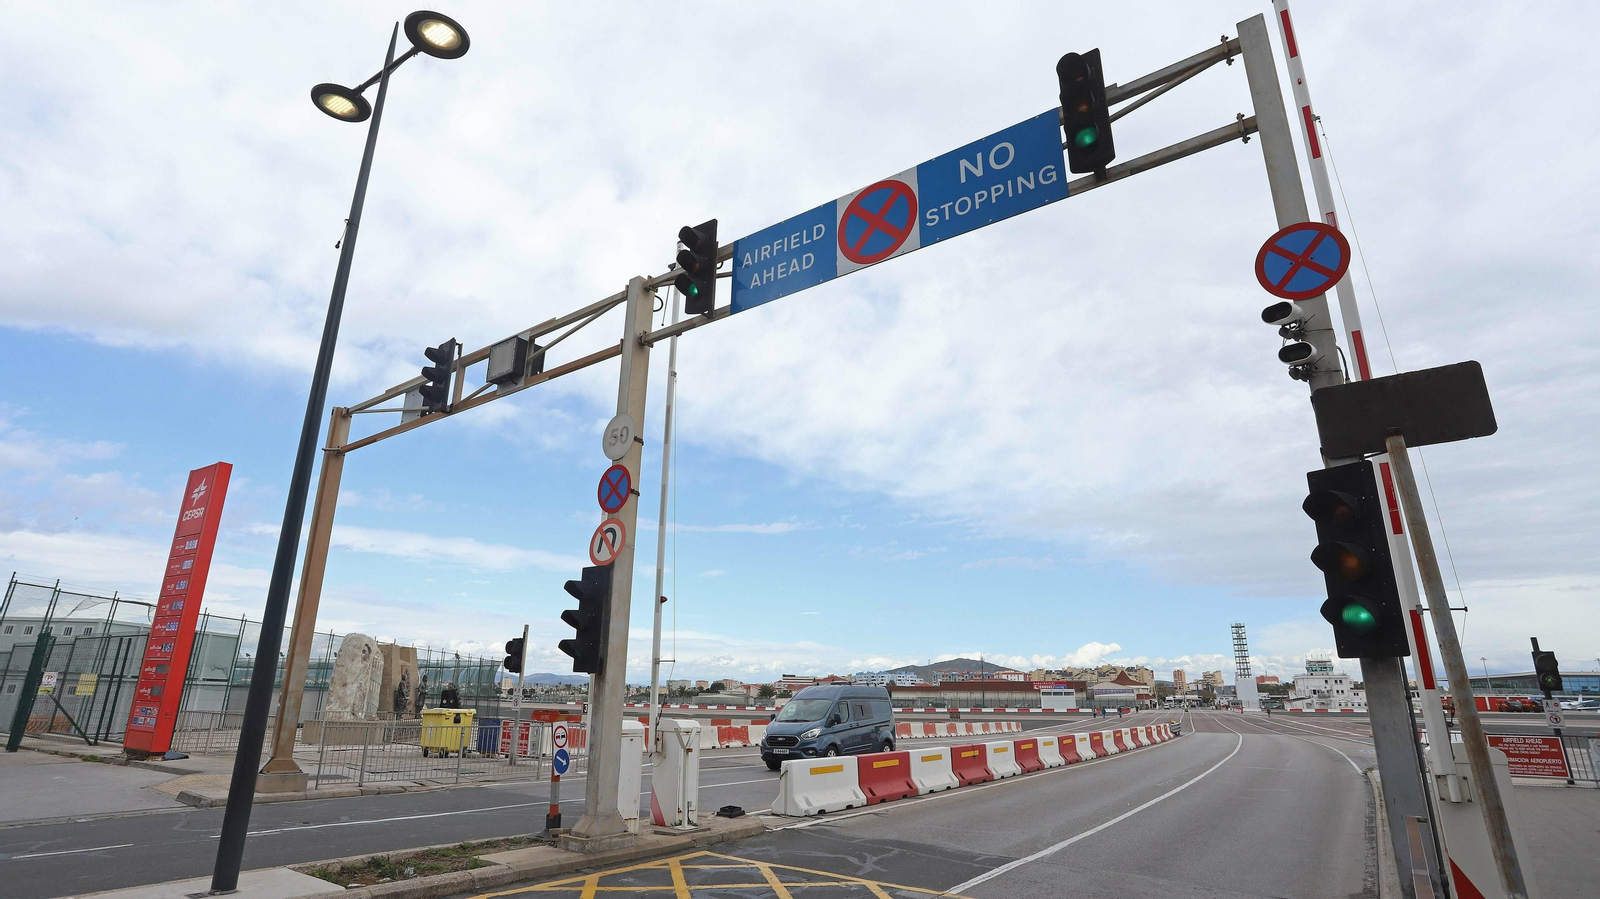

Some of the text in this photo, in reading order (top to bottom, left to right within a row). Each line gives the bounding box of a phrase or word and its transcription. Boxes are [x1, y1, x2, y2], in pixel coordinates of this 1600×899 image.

[959, 141, 1015, 183] NO
[925, 164, 1057, 227] STOPPING
[741, 223, 826, 269] AIRFIELD
[749, 253, 815, 290] AHEAD
[608, 426, 629, 446] 50
[182, 507, 204, 521] CEPSA
